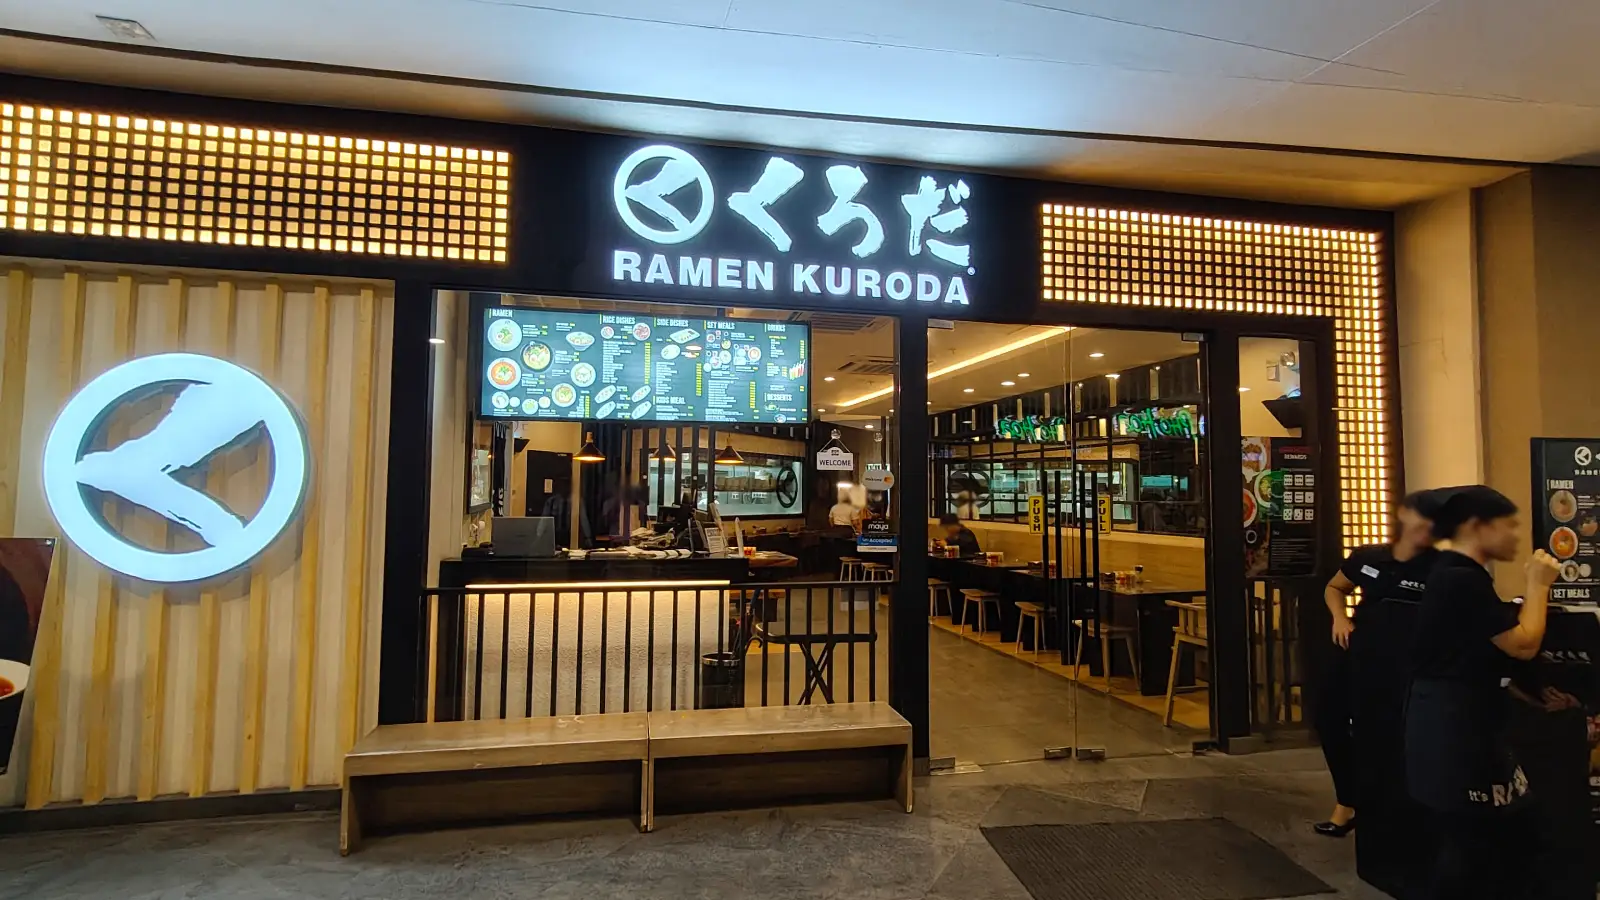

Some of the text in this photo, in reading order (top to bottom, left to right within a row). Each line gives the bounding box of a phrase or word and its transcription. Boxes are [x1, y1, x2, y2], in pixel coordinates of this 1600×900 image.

[727, 156, 971, 267] くろだ
[613, 249, 970, 305] RAMEN KURODA
[492, 309, 513, 318] RAMEN
[602, 315, 636, 324] RICE DISHES
[656, 318, 689, 327] SIDE DISHES
[707, 321, 735, 330] SET MEALS
[671, 396, 686, 405] MEAL
[766, 393, 793, 401] DESSERTS
[819, 459, 852, 467] WELCOME
[1032, 499, 1041, 532] PUSH
[1098, 499, 1107, 532] PULL
[867, 523, 889, 532] maya
[1553, 588, 1566, 599] SET
